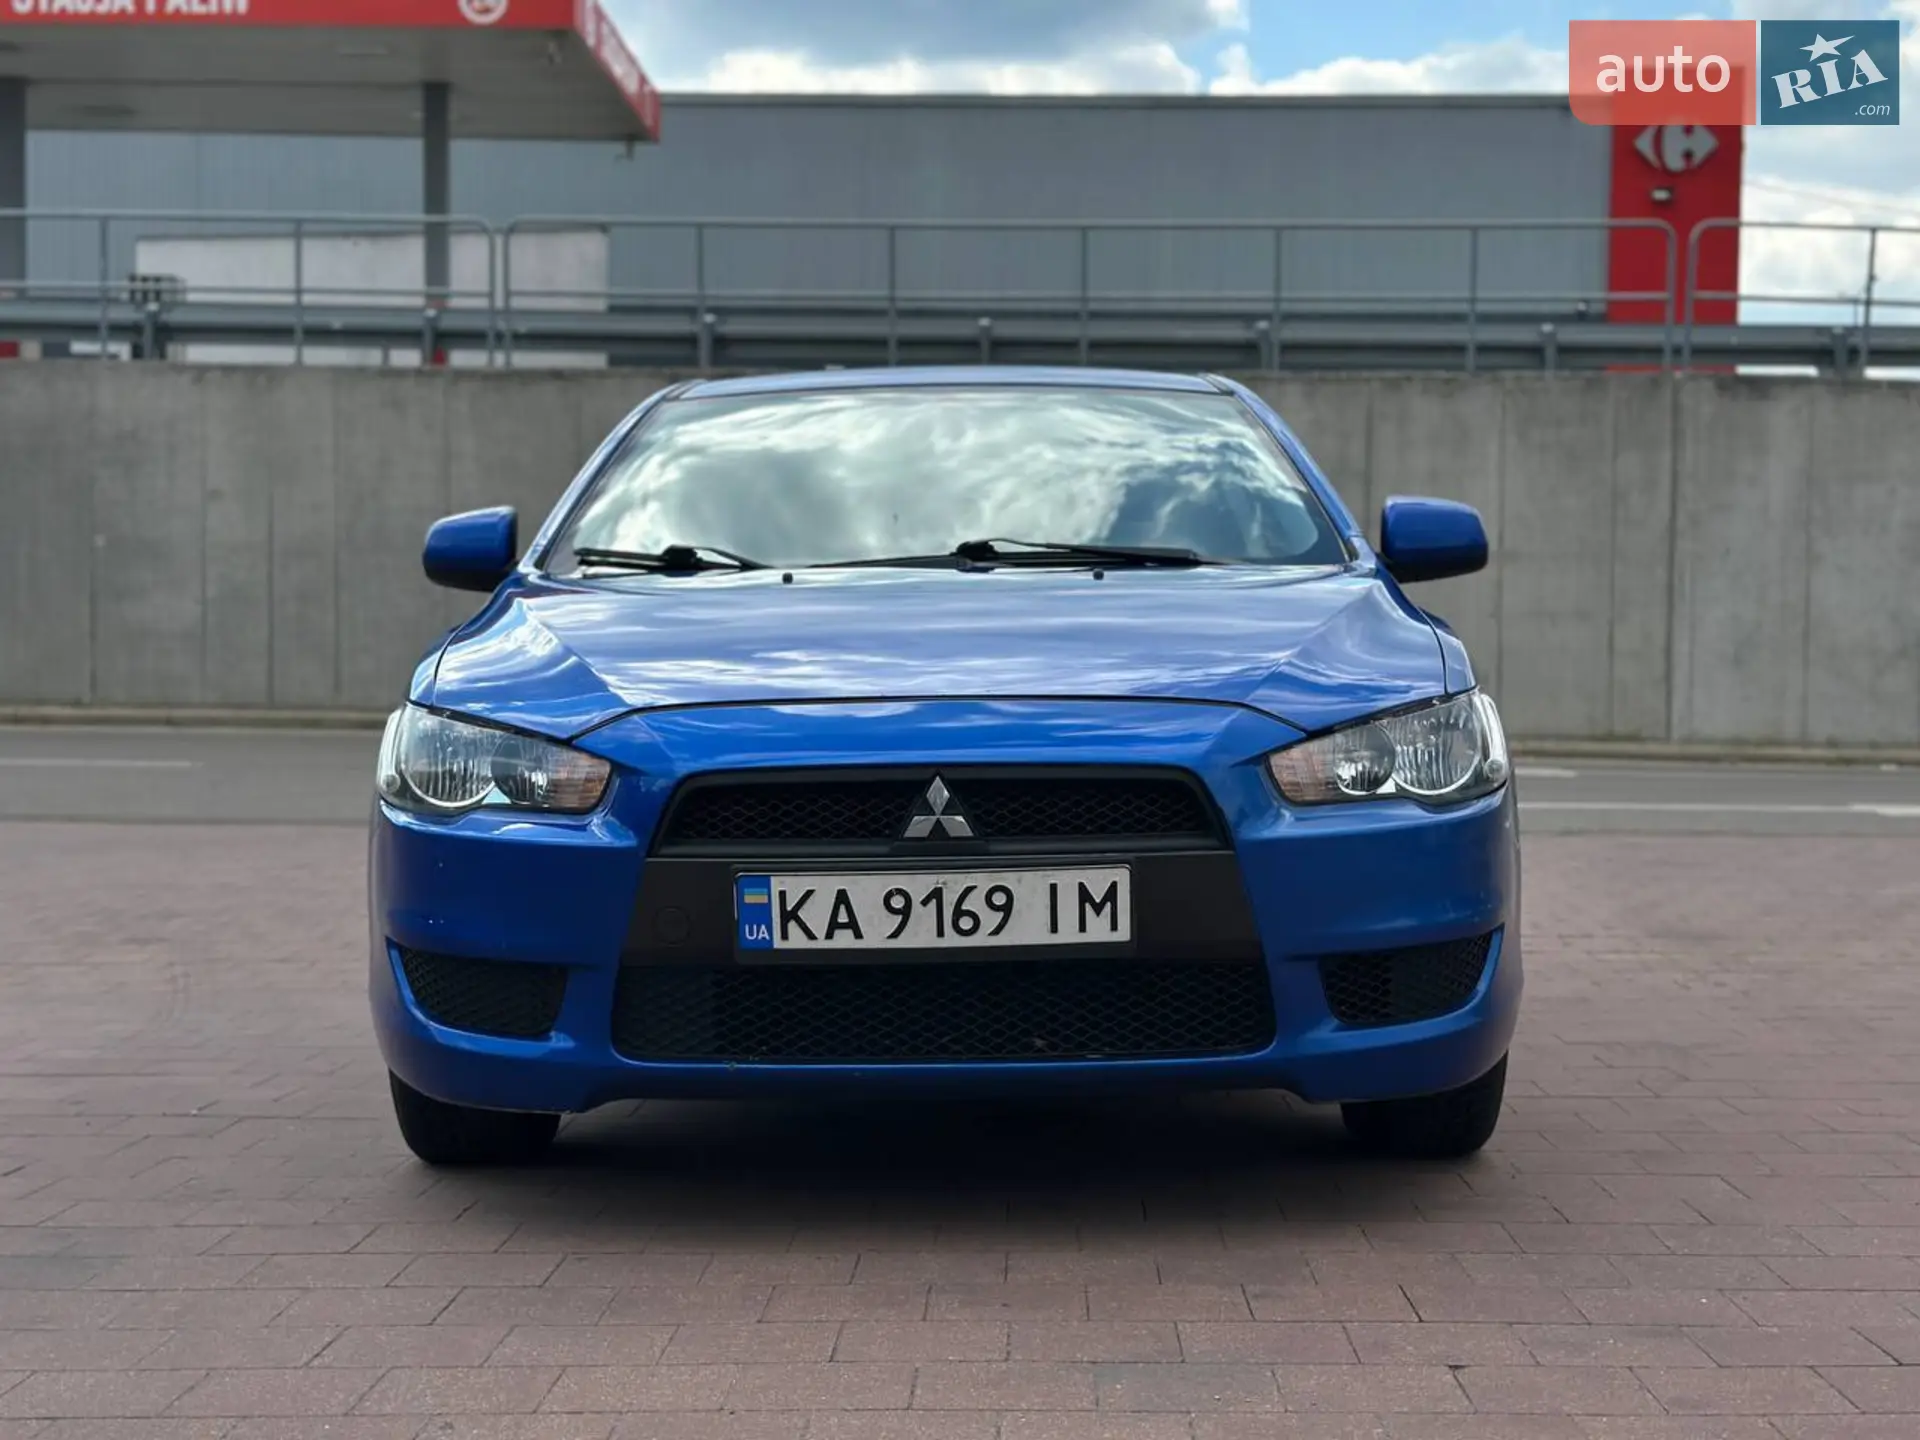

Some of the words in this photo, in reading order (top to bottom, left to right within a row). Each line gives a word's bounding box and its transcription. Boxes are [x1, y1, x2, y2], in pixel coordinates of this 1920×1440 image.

[778, 888, 865, 941] KA
[882, 884, 1015, 940] 9169
[1048, 880, 1119, 934] IM
[745, 924, 770, 941] UA
